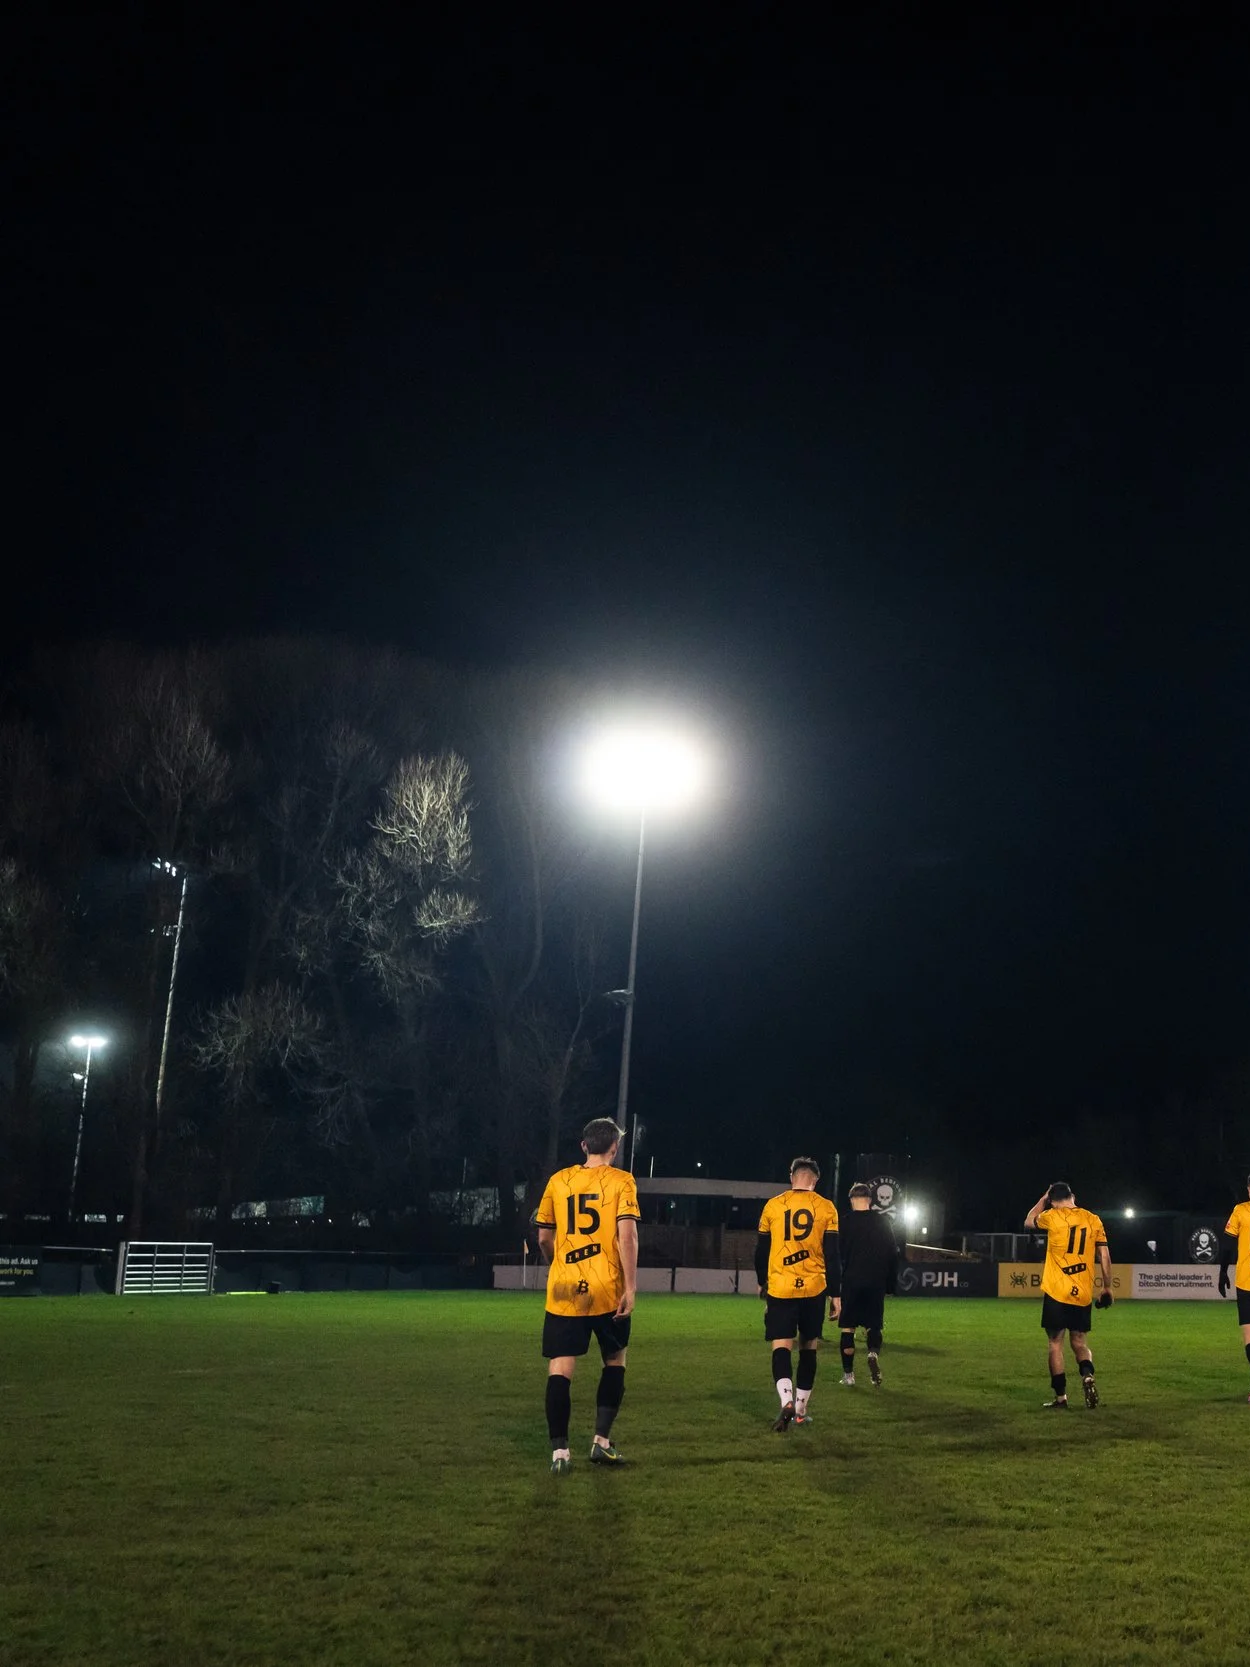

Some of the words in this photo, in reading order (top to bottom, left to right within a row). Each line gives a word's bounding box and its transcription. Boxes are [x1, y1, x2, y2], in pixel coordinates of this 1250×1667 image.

[567, 1193, 600, 1236] 15
[784, 1208, 814, 1241] 19
[1067, 1225, 1087, 1255] 11
[568, 1245, 599, 1262] IREN
[922, 1272, 958, 1287] PJH
[1154, 1273, 1177, 1282] global
